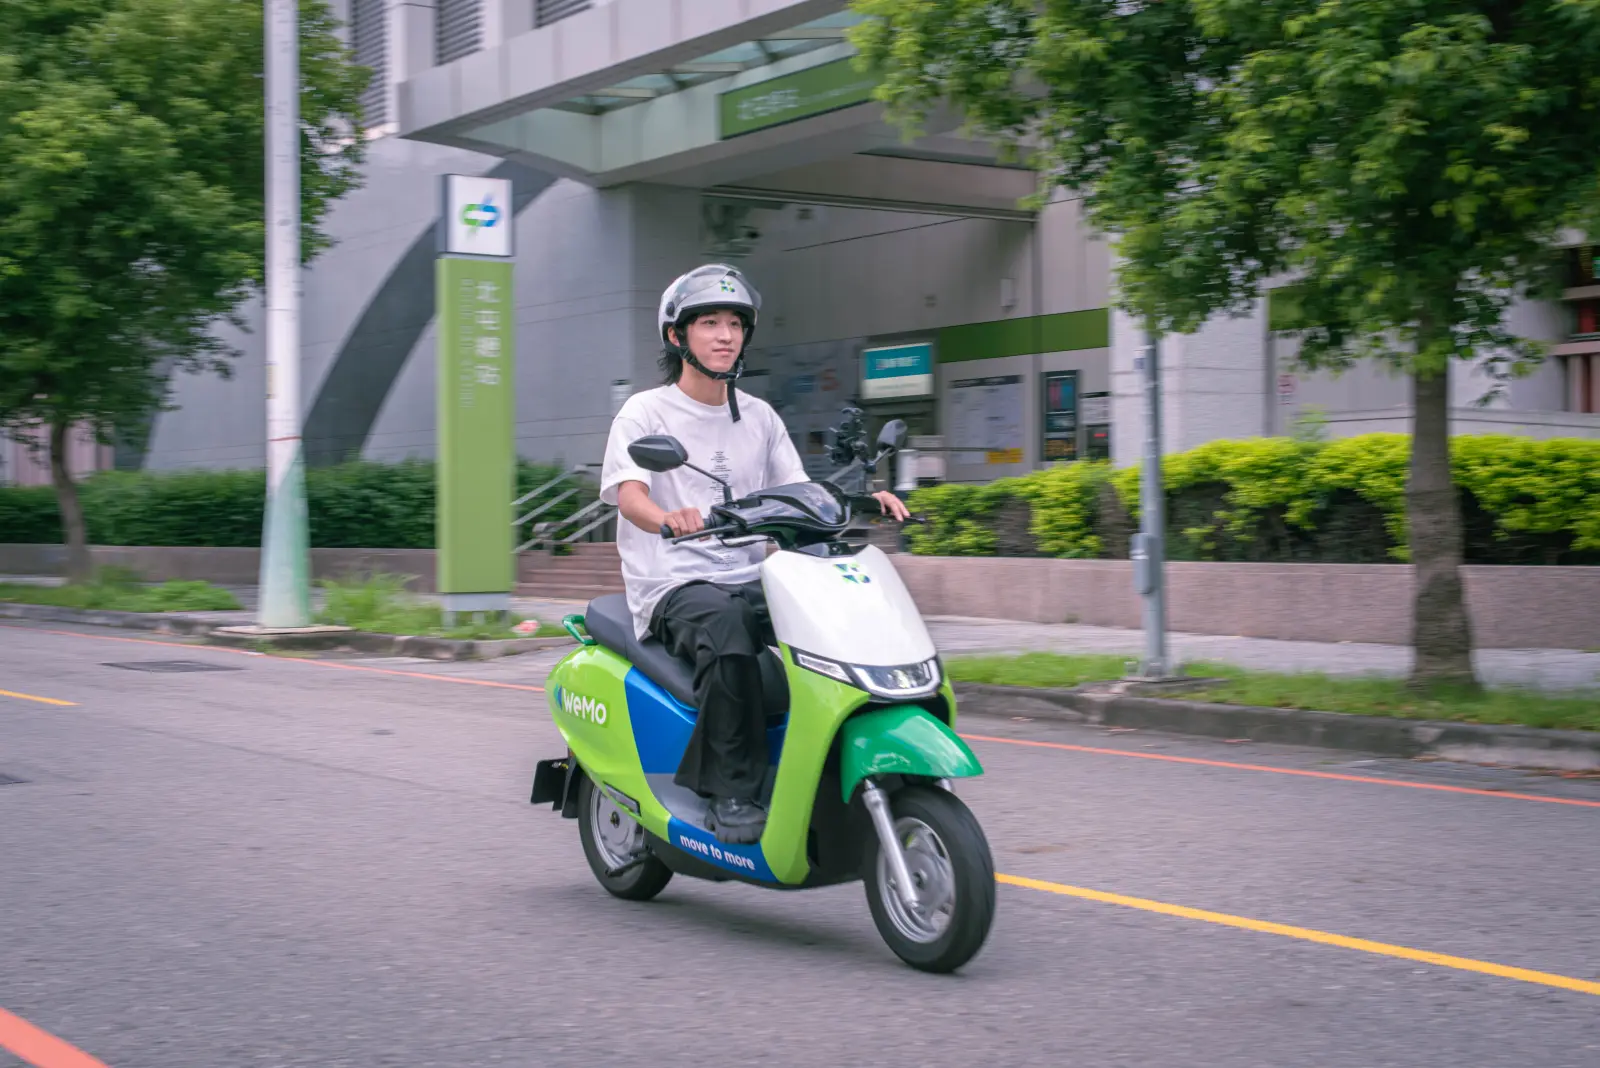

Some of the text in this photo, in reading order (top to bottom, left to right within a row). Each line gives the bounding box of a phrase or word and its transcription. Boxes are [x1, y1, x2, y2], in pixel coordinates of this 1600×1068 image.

[563, 688, 607, 725] WeMo
[680, 834, 755, 870] move to more
